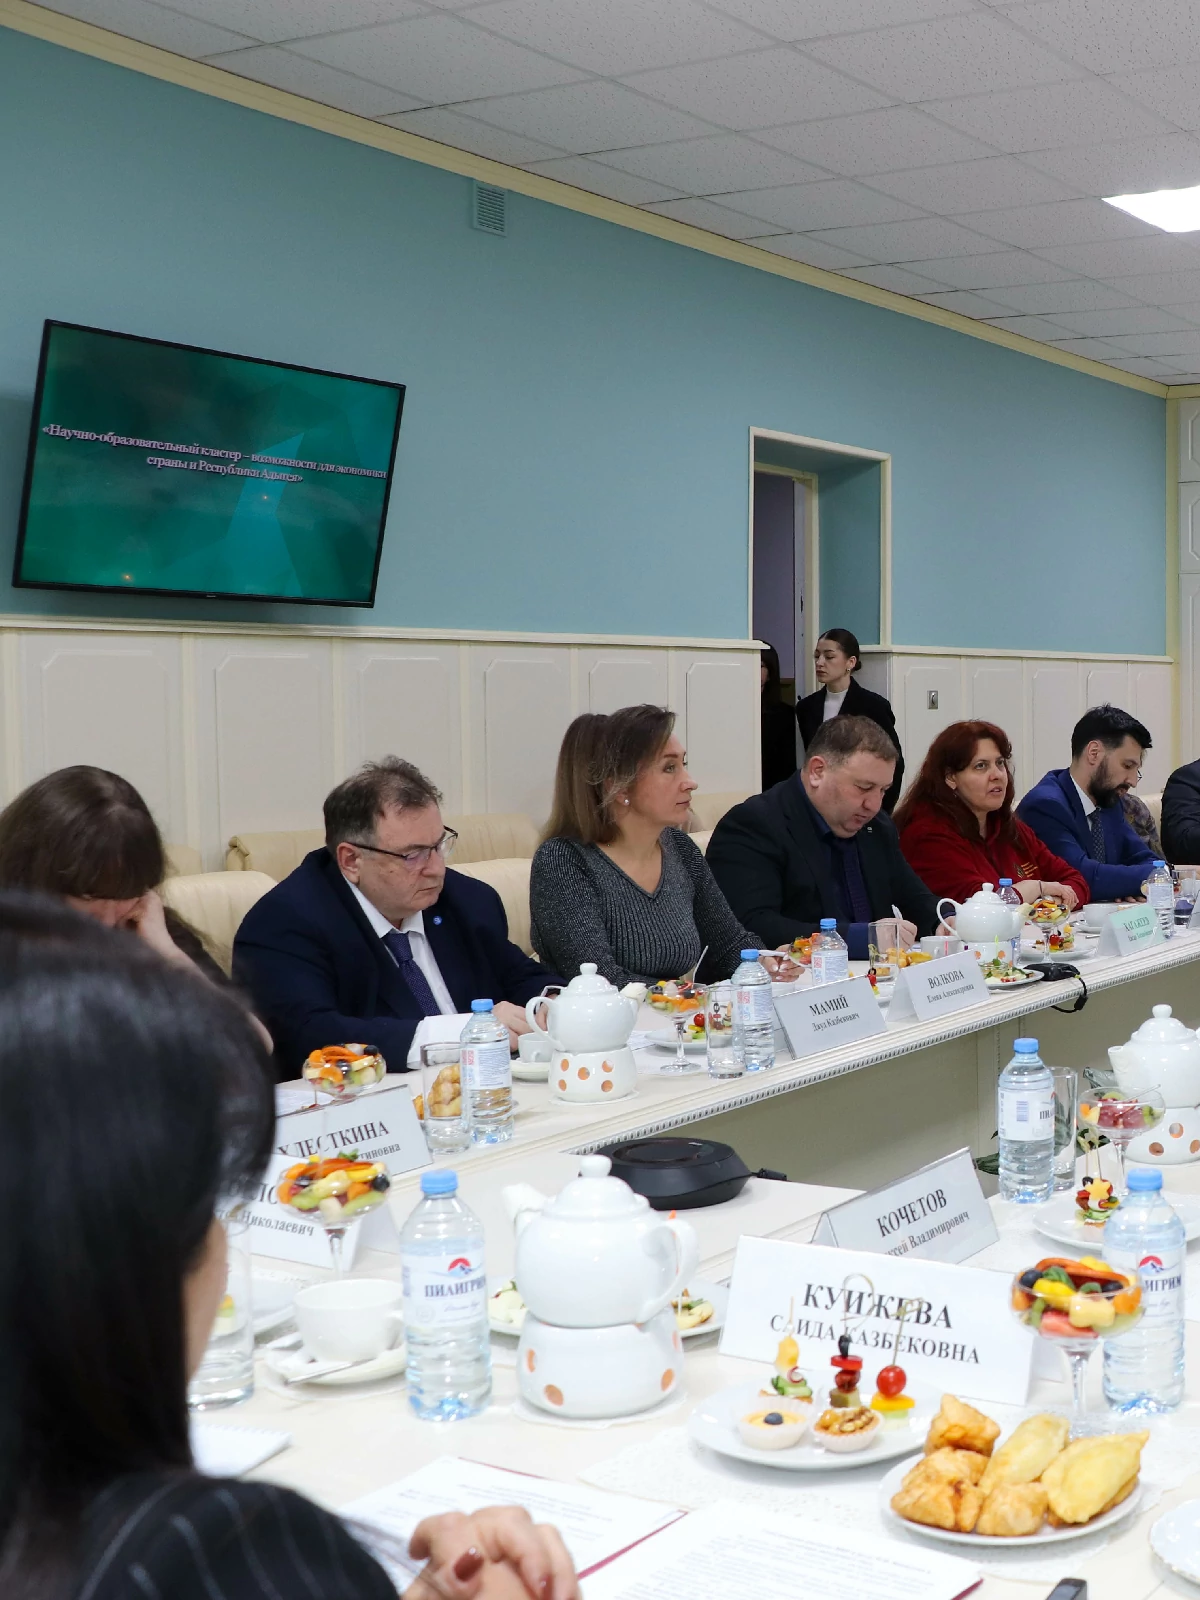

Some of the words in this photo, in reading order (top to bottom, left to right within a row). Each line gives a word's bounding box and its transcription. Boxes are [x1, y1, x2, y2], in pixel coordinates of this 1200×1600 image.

[42, 424, 200, 455] «Научно-образовательный
[201, 447, 242, 462] кластер
[251, 453, 317, 470] возможности
[317, 463, 336, 473] для
[336, 465, 387, 479] экономики
[147, 456, 188, 469] страны
[189, 460, 198, 470] и
[199, 460, 260, 478] Республики
[927, 969, 965, 989] ВОЛКОВА
[927, 994, 942, 1003] Елена
[942, 983, 975, 999] Александровна
[809, 994, 849, 1016] МАМИЙ
[876, 1188, 947, 1238] КОЧЕТОВ
[908, 1211, 970, 1247] Владимирович
[424, 1276, 486, 1297] ПИЛИГРИ
[1144, 1274, 1182, 1292] ИГРИМ
